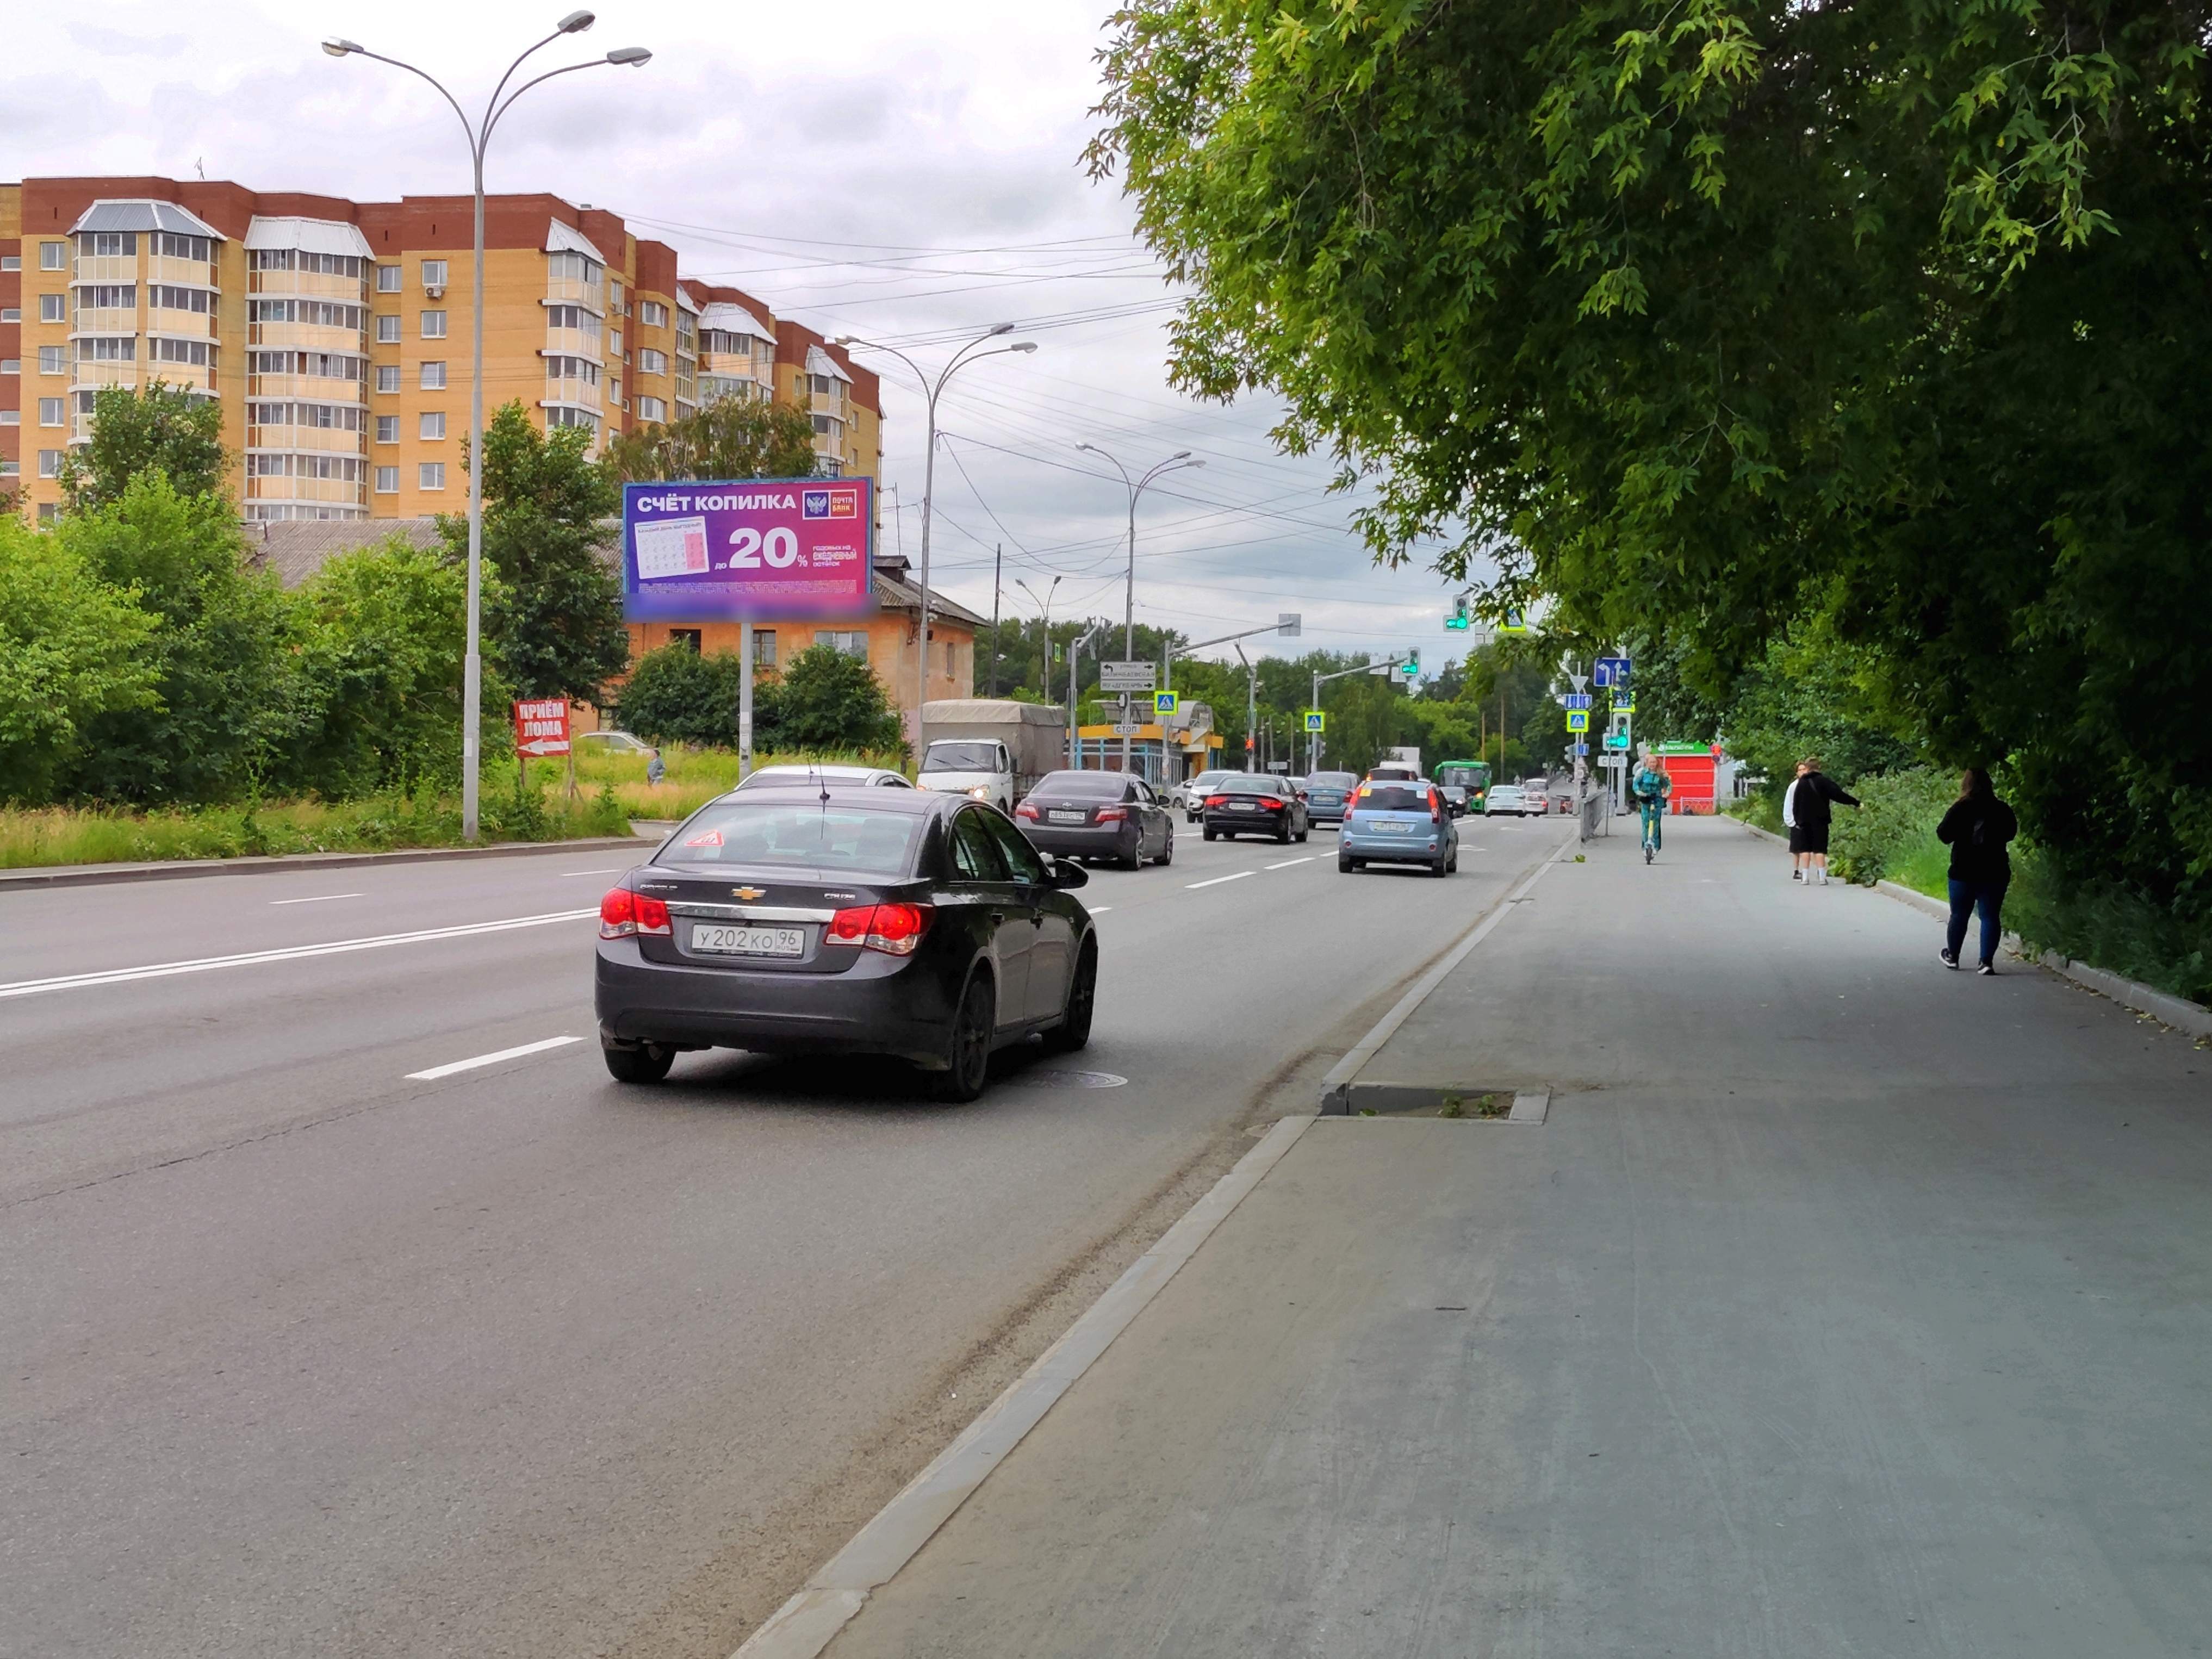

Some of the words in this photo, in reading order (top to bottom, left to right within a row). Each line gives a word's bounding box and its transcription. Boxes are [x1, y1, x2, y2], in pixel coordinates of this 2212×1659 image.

[637, 493, 691, 512] СЧЁТ
[695, 494, 797, 511] КОПИЛКА
[519, 700, 564, 719] ПРИЁМ
[523, 720, 563, 737] ЛОМА
[779, 931, 796, 946] 96
